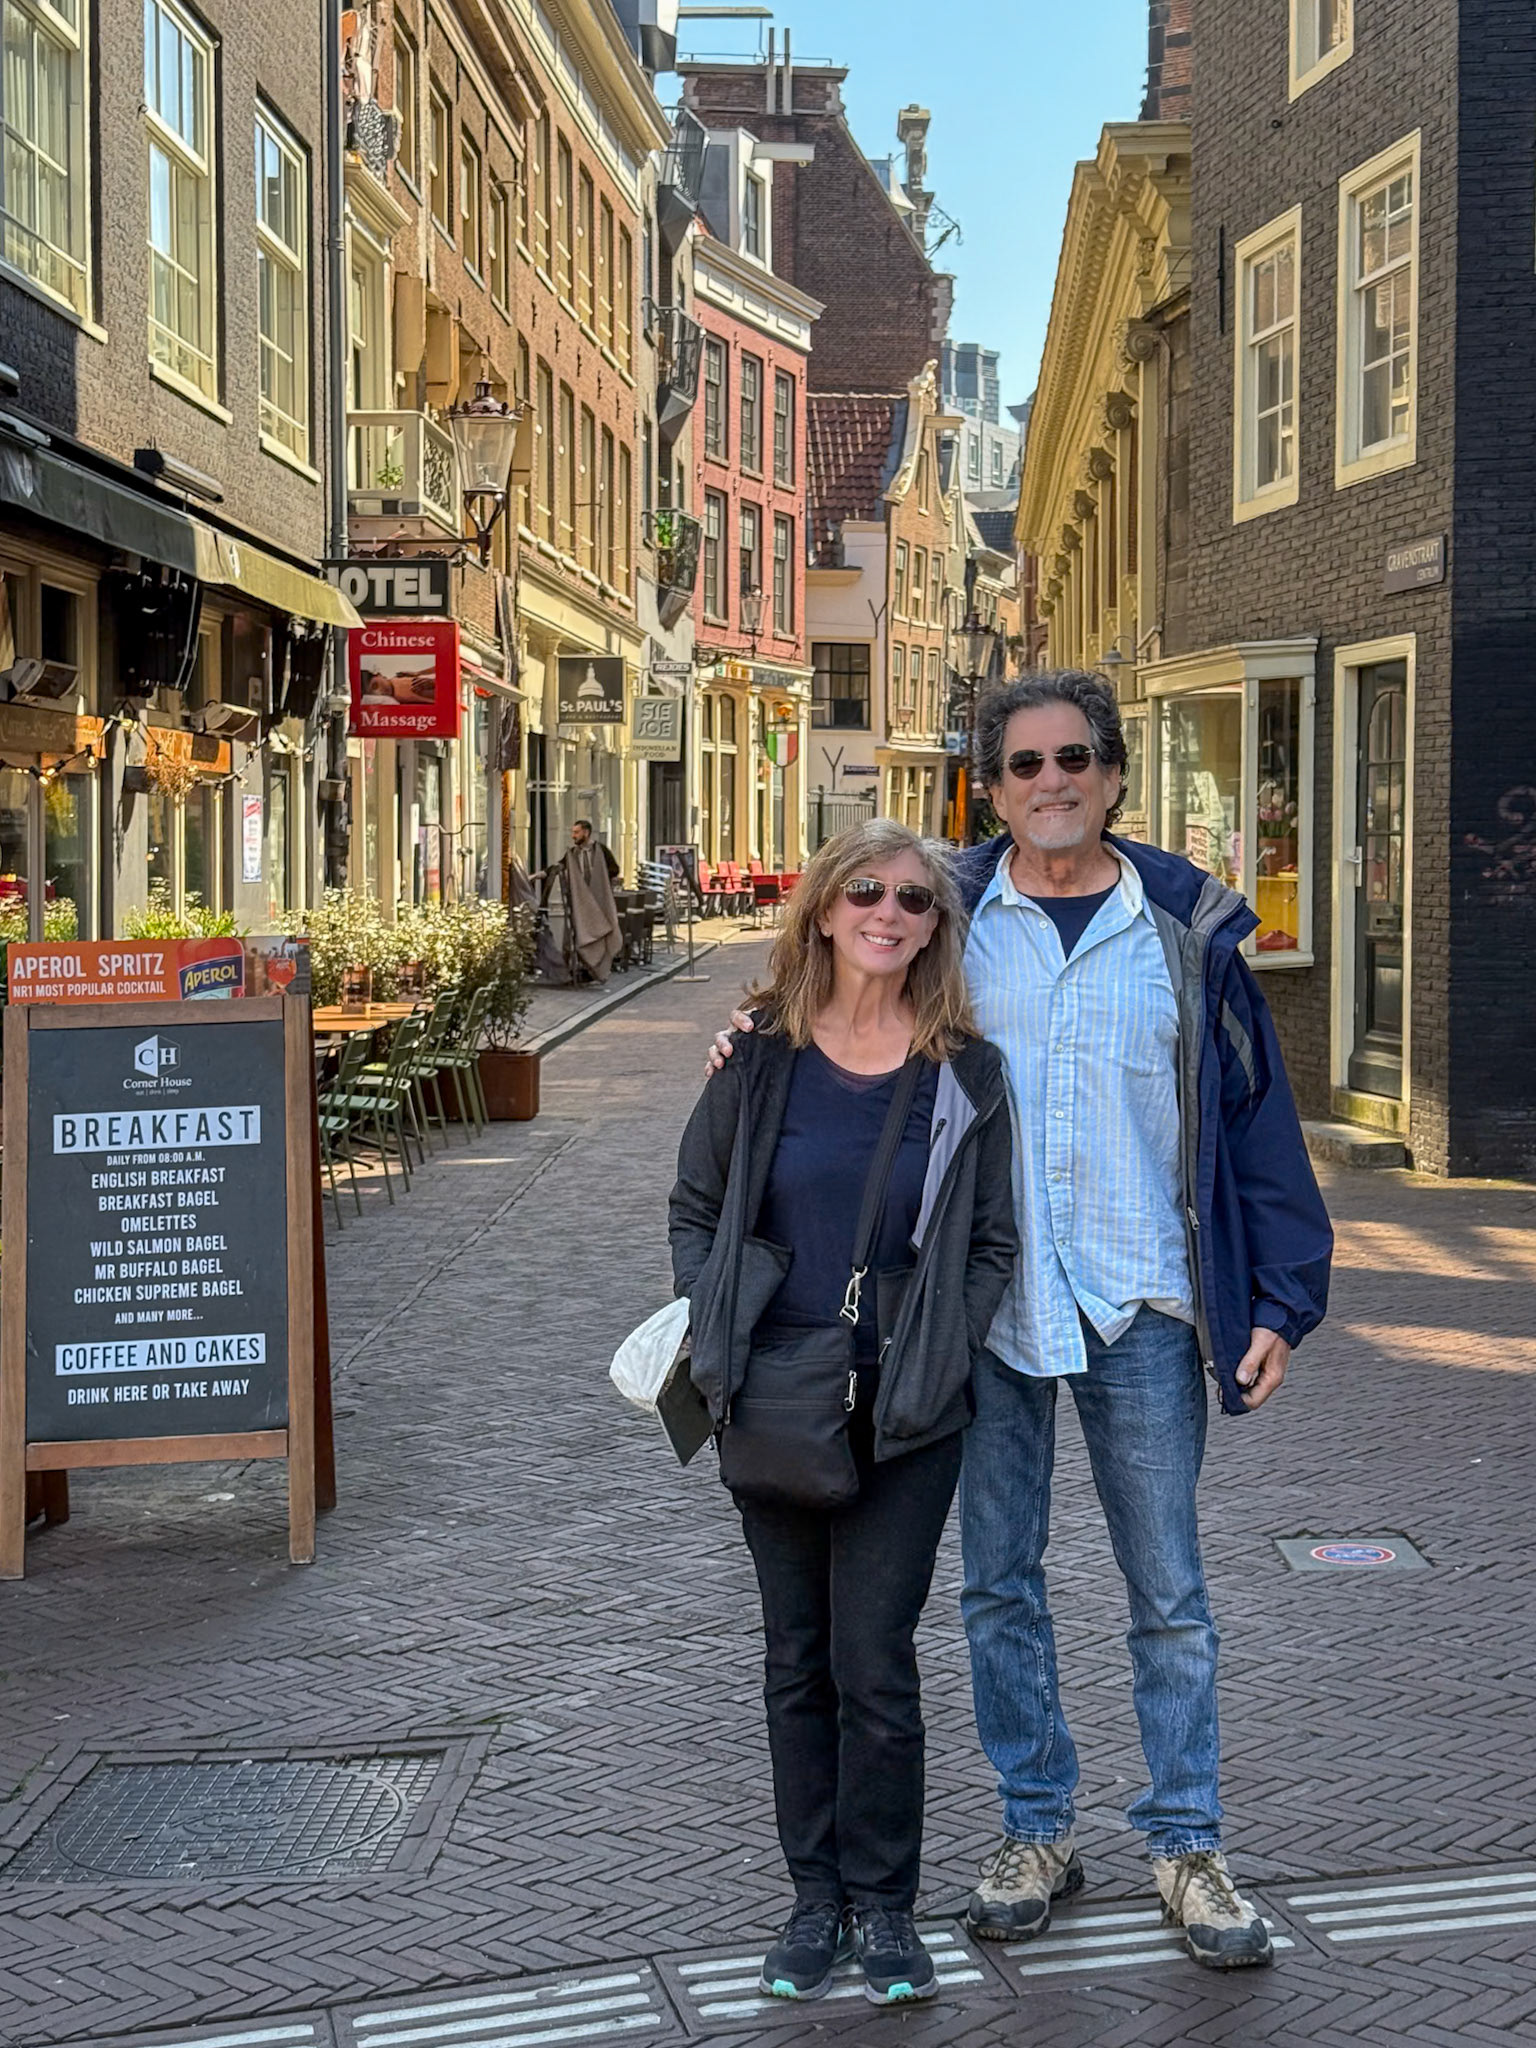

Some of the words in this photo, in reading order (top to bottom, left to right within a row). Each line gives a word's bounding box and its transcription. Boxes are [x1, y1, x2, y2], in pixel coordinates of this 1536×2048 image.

[327, 566, 443, 607] OTEL
[360, 631, 436, 648] Chinese
[560, 701, 576, 713] St
[576, 699, 623, 713] PAUL'S
[641, 702, 673, 720] SIE
[360, 711, 437, 731] Massage
[638, 720, 674, 737] JOE
[13, 956, 87, 979] APEROL
[98, 953, 165, 977] SPRITZ
[184, 963, 238, 992] APEROL
[13, 985, 33, 998] NR1
[36, 984, 65, 997] MOST
[67, 983, 114, 996] POPULAR
[117, 981, 166, 995] COCKTAIL
[123, 1077, 158, 1090] Corner
[160, 1076, 192, 1088] House
[61, 1110, 254, 1148] BREAKFAST
[107, 1155, 130, 1166] DAILY
[132, 1154, 156, 1165] FROM
[158, 1153, 184, 1164] 08:00
[186, 1152, 205, 1163] A.M.
[91, 1172, 147, 1189] ENGLISH
[151, 1168, 226, 1187] BREAKFAST
[99, 1193, 172, 1211] BREAKFAST
[177, 1191, 219, 1208] BAGEL
[121, 1214, 197, 1233] OMELETTES
[90, 1241, 123, 1257] WILD
[127, 1238, 182, 1255] SALMON
[186, 1235, 228, 1252] BAGEL
[95, 1264, 115, 1280] MR
[119, 1261, 178, 1278] BUFFALO
[181, 1258, 223, 1275] BAGEL
[74, 1288, 132, 1304] CHICKEN
[135, 1284, 198, 1301] SUPREME
[202, 1280, 243, 1297] BAGEL
[115, 1312, 134, 1325] AND
[136, 1311, 164, 1323] MANY
[167, 1309, 203, 1322] MORE...
[62, 1345, 138, 1371] COFFEE
[146, 1342, 186, 1366] AND
[195, 1337, 260, 1364] CAKES
[68, 1387, 109, 1406] DRINK
[114, 1386, 148, 1403] HERE
[152, 1384, 170, 1401] OR
[174, 1382, 208, 1399] TAKE
[211, 1379, 250, 1397] AWAY
